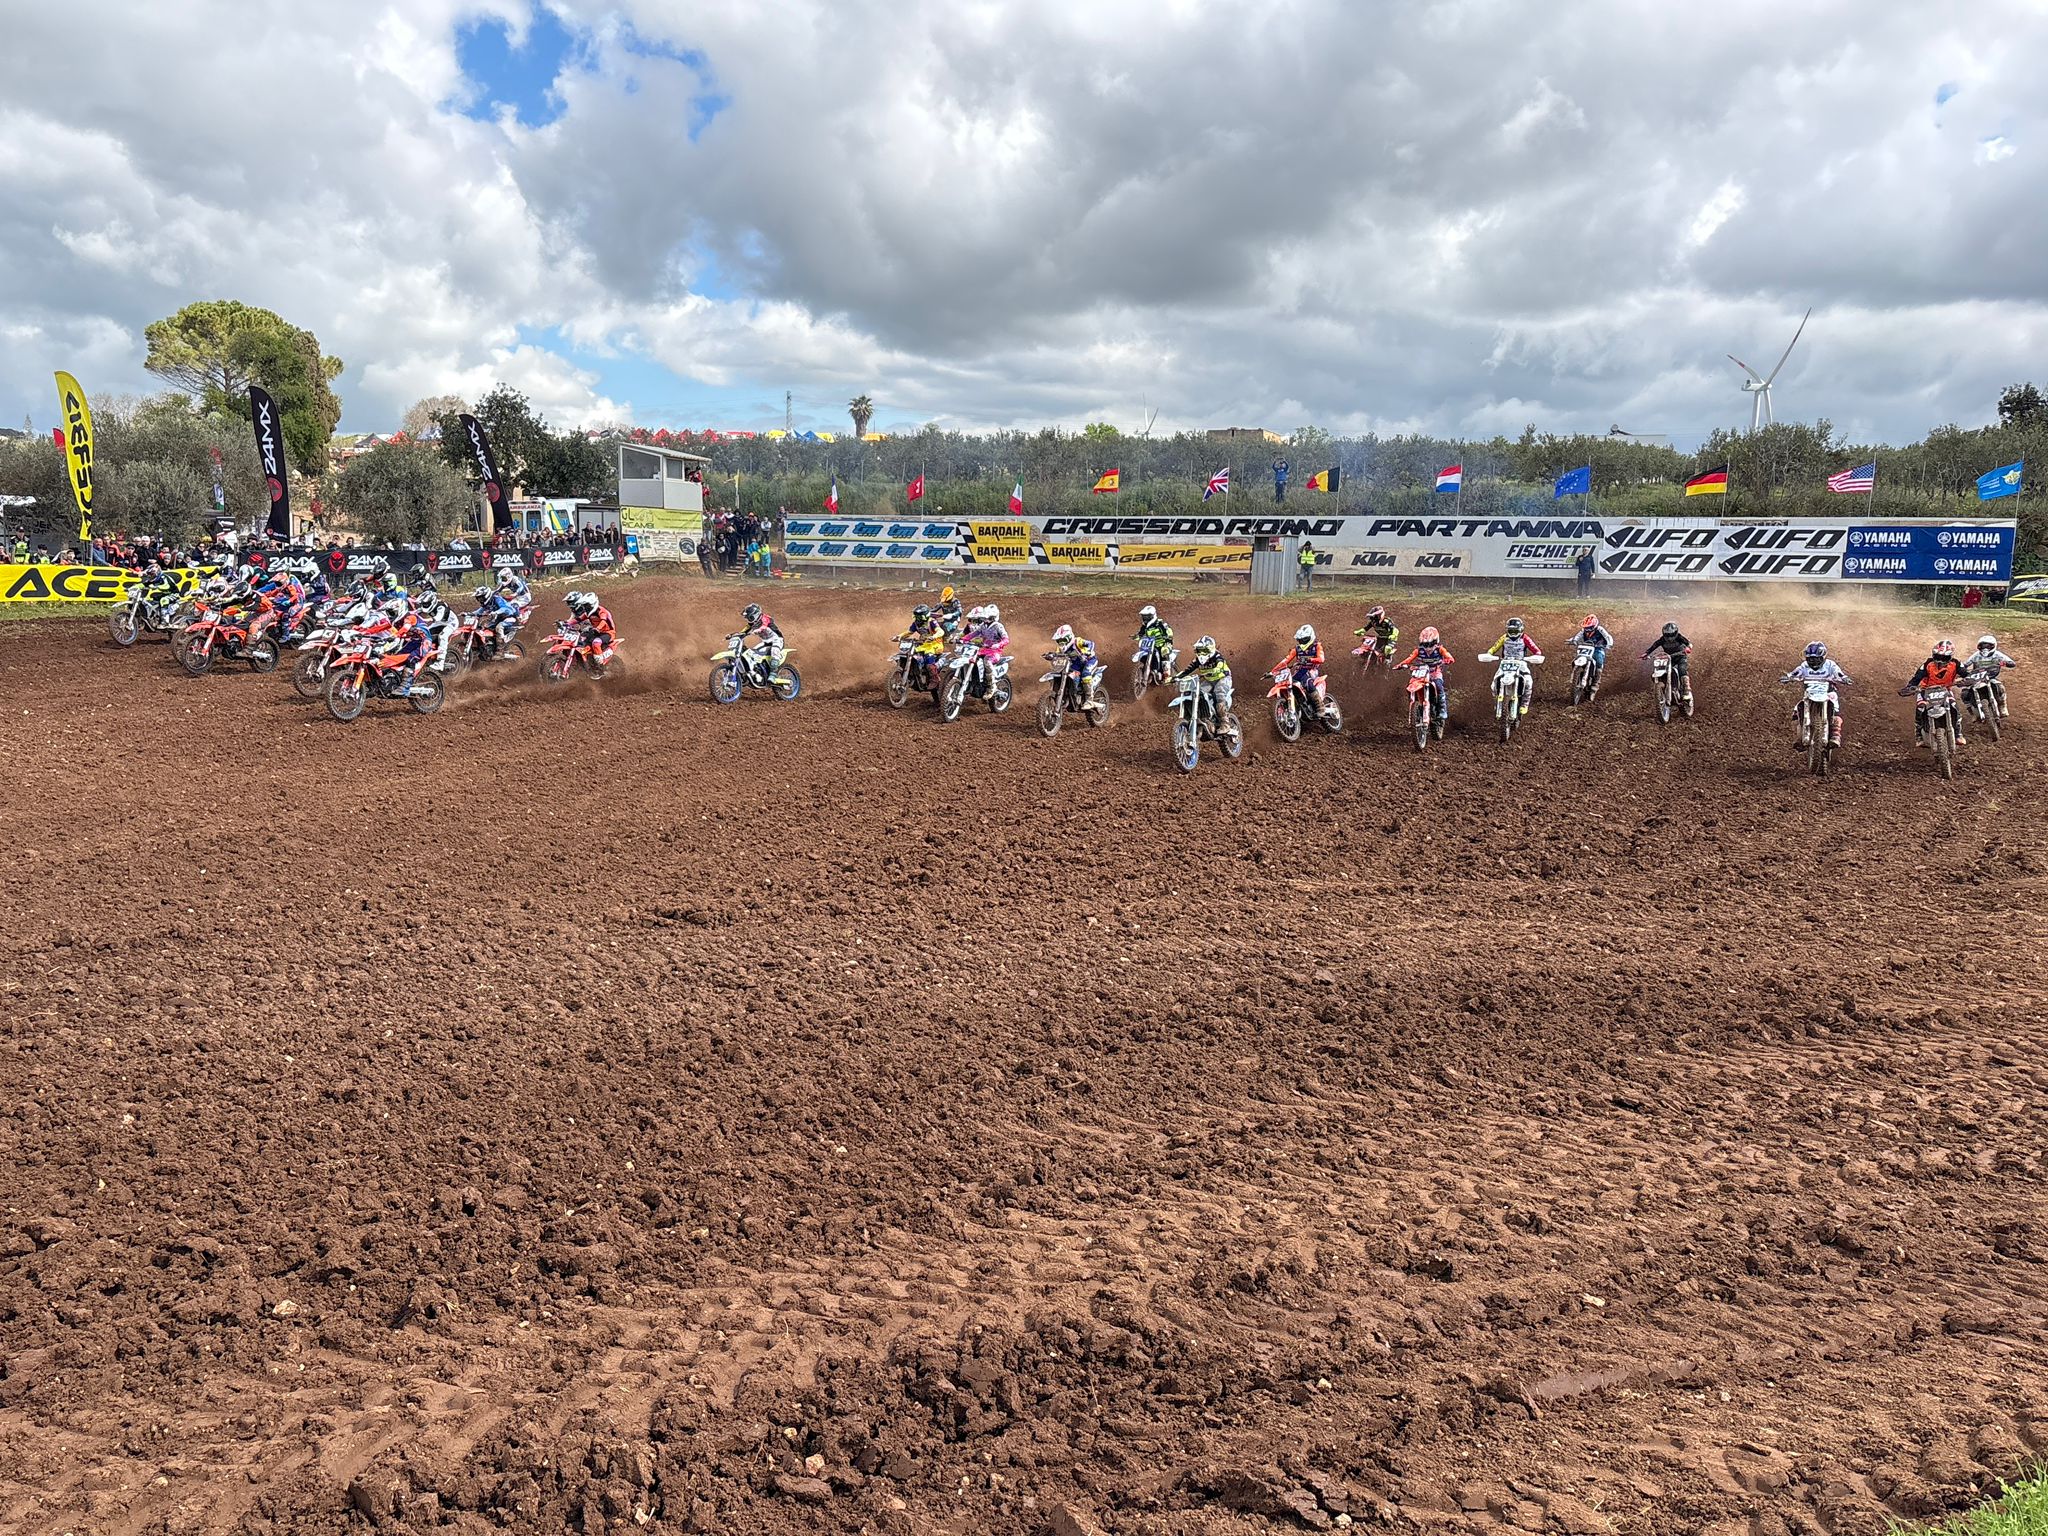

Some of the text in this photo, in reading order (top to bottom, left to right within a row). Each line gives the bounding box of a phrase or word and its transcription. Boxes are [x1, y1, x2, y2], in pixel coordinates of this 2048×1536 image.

[259, 399, 277, 475] 24MX
[468, 421, 493, 481] 24MX
[978, 526, 1026, 541] BARDAHL
[1041, 518, 1604, 539] CROSSODROMO PARTANNA
[1624, 529, 1720, 548] UFO
[1744, 529, 1847, 549] UFO
[1863, 532, 1911, 543] YAMAHA
[1952, 532, 2000, 544] YAMAHA
[348, 555, 388, 565] 24MX
[439, 554, 472, 565] 24MX
[493, 553, 522, 563] 24MX
[545, 550, 575, 560] 24MX
[590, 548, 612, 557] 24MX
[977, 546, 1025, 561] BARDAHL
[1052, 547, 1102, 562] BARDAHL
[1199, 552, 1251, 564] GAER
[1351, 551, 1397, 566] KTM
[1414, 553, 1462, 568] KTM
[1618, 553, 1714, 572] UFO
[1738, 554, 1840, 574] UFO
[1859, 558, 1906, 570] YAMAHA
[1950, 559, 1997, 571] YAMAHA
